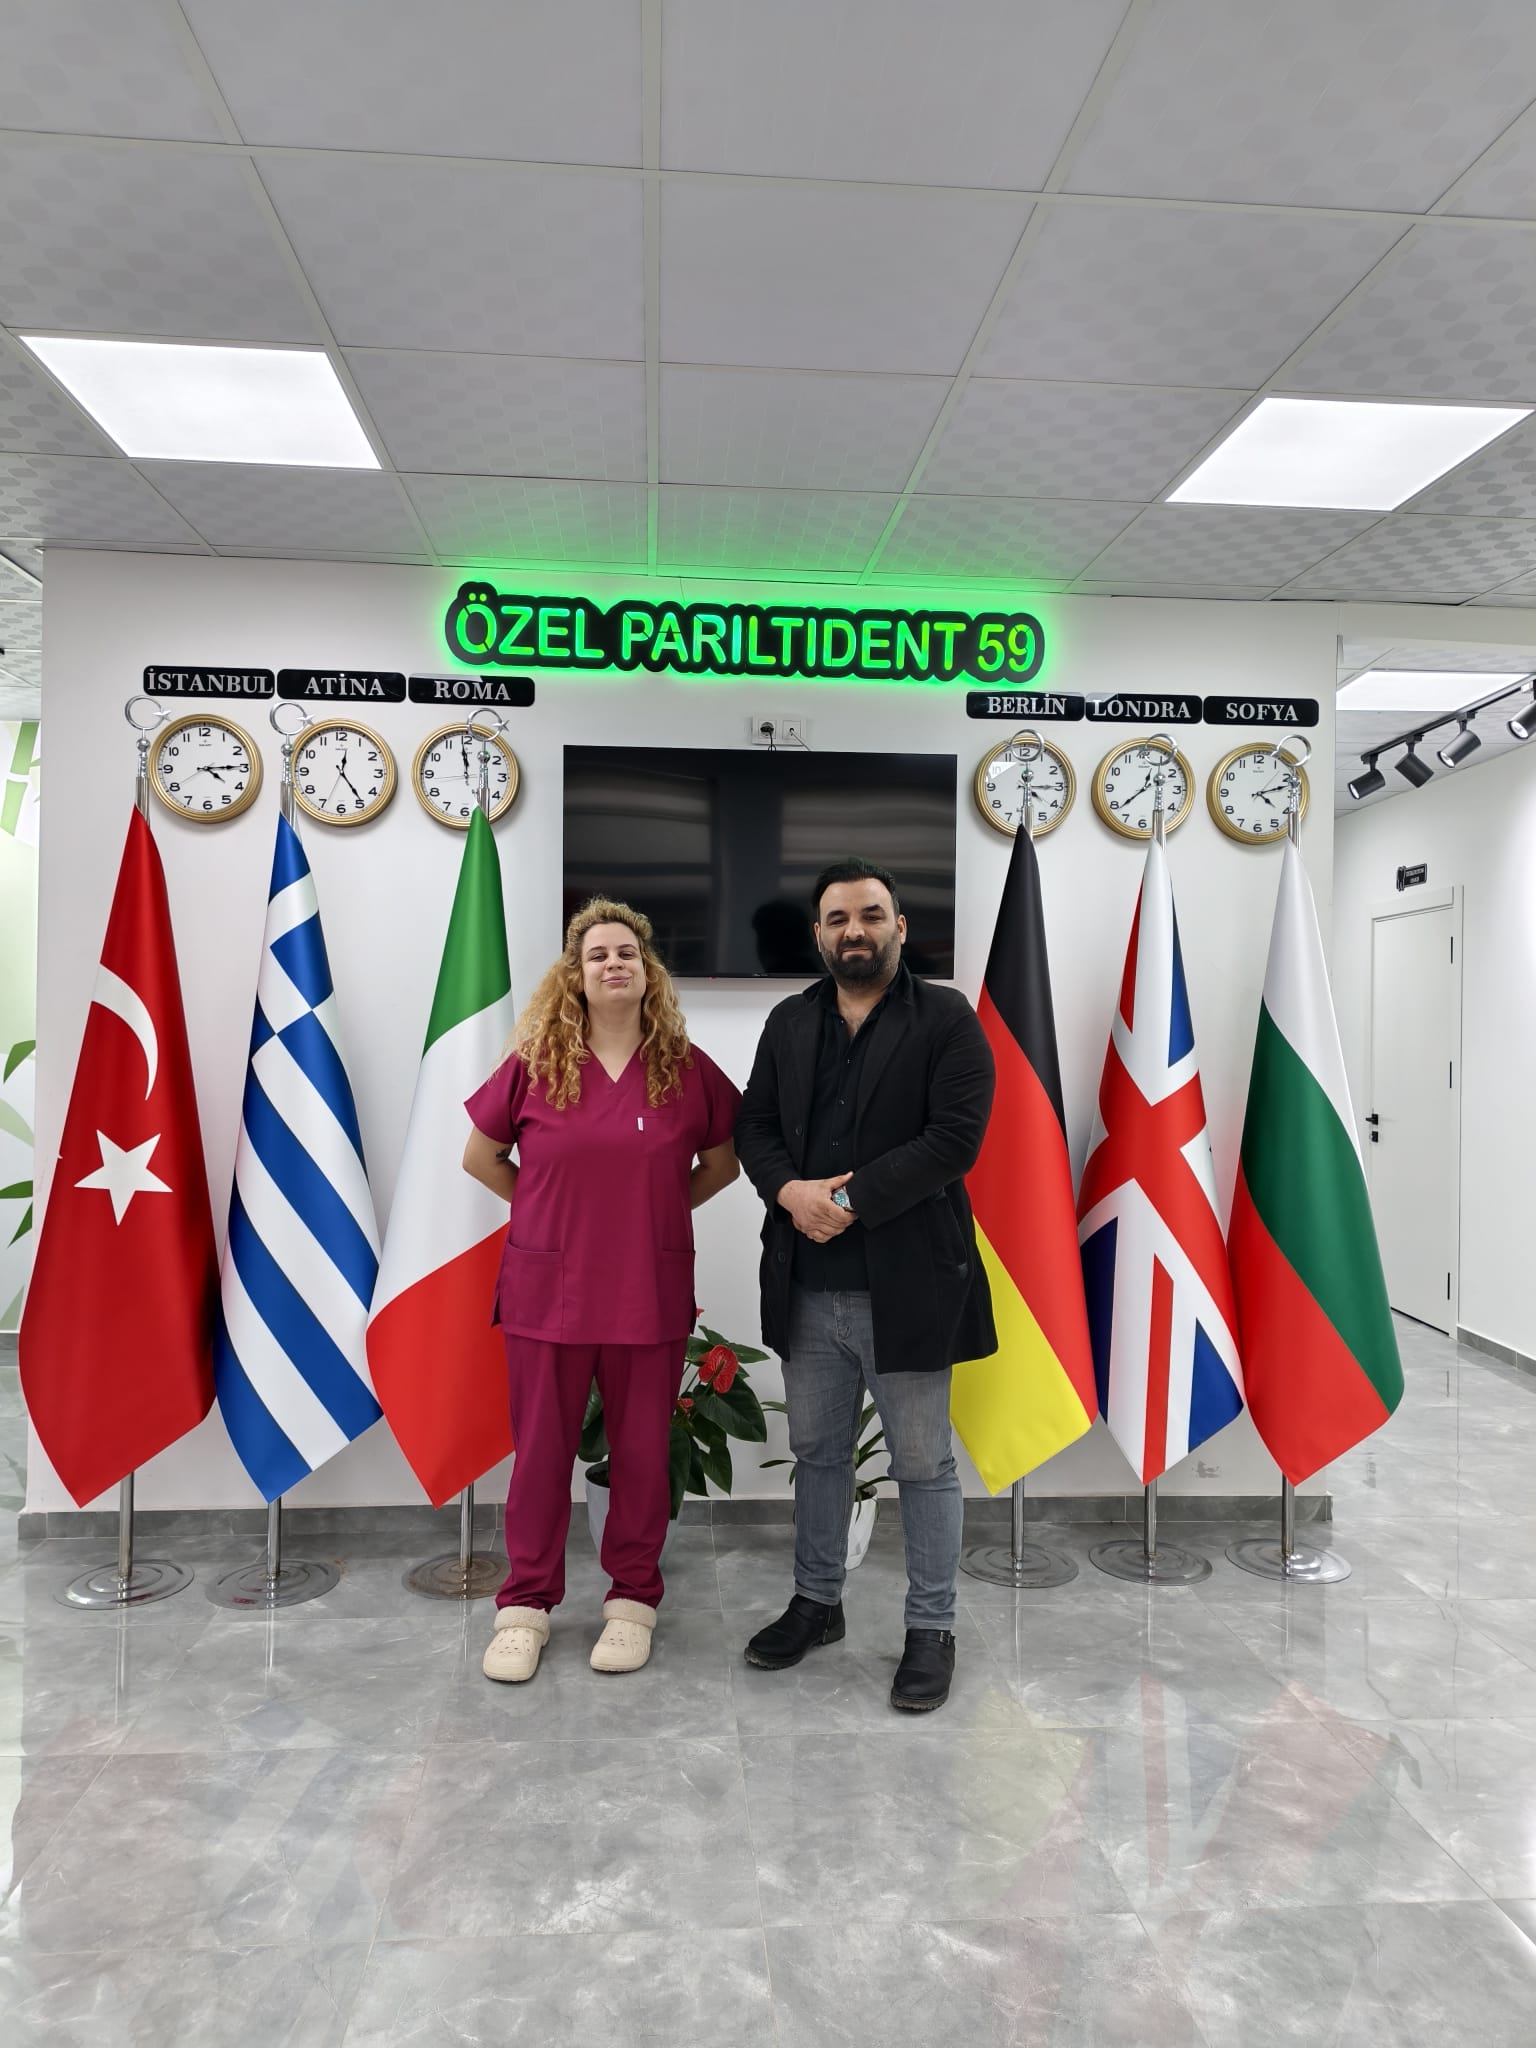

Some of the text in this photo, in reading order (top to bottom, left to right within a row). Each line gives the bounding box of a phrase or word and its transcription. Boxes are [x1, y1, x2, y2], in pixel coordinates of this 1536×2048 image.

[456, 592, 1035, 672] ÖZEL PARILTIDENT 59
[148, 668, 273, 694] İSTANBUL
[304, 673, 385, 696] ATİNA
[434, 680, 511, 700] ROMA
[987, 694, 1066, 715] BERLİN
[1093, 700, 1191, 718] LONDRA
[1226, 703, 1299, 721] SOFYA
[199, 728, 211, 736] 12
[336, 732, 347, 741] 12
[461, 736, 472, 745] 12
[169, 747, 179, 756] 10
[233, 746, 242, 755] 2
[305, 750, 316, 759] 10
[368, 752, 377, 761] 2
[431, 753, 440, 762] 10
[492, 756, 501, 765] 2
[1253, 755, 1264, 763] 12
[163, 765, 173, 773] 9
[240, 764, 249, 772] 3
[300, 767, 309, 776] 9
[1049, 766, 1058, 774] 2
[1112, 767, 1120, 776] 10
[374, 769, 383, 778] 3
[424, 770, 434, 778] 9
[497, 773, 506, 782] 3
[1168, 769, 1177, 778] 2
[1226, 772, 1235, 781] 10
[170, 783, 180, 791] 8
[235, 782, 244, 790] 4
[305, 785, 315, 794] 8
[987, 783, 995, 791] 9
[1054, 783, 1063, 791] 3
[1106, 784, 1114, 792] 9
[1173, 786, 1181, 794] 3
[368, 787, 377, 796] 4
[430, 788, 440, 796] 8
[492, 791, 500, 799] 4
[1220, 789, 1229, 797] 9
[184, 796, 192, 805] 7
[222, 795, 231, 804] 5
[319, 799, 327, 808] 7
[355, 800, 364, 808] 5
[992, 800, 1001, 808] 8
[1050, 800, 1058, 808] 4
[203, 801, 212, 810] 6
[337, 804, 346, 813] 6
[443, 802, 451, 811] 7
[1110, 801, 1119, 809] 8
[1168, 803, 1175, 811] 4
[460, 808, 470, 816] 6
[1225, 806, 1234, 814] 8
[1005, 813, 1013, 821] 7
[1038, 812, 1047, 821] 5
[1122, 814, 1130, 823] 7
[1138, 820, 1147, 828] 6
[1237, 819, 1245, 828] 7
[1270, 819, 1279, 827] 5
[1253, 824, 1262, 832] 6
